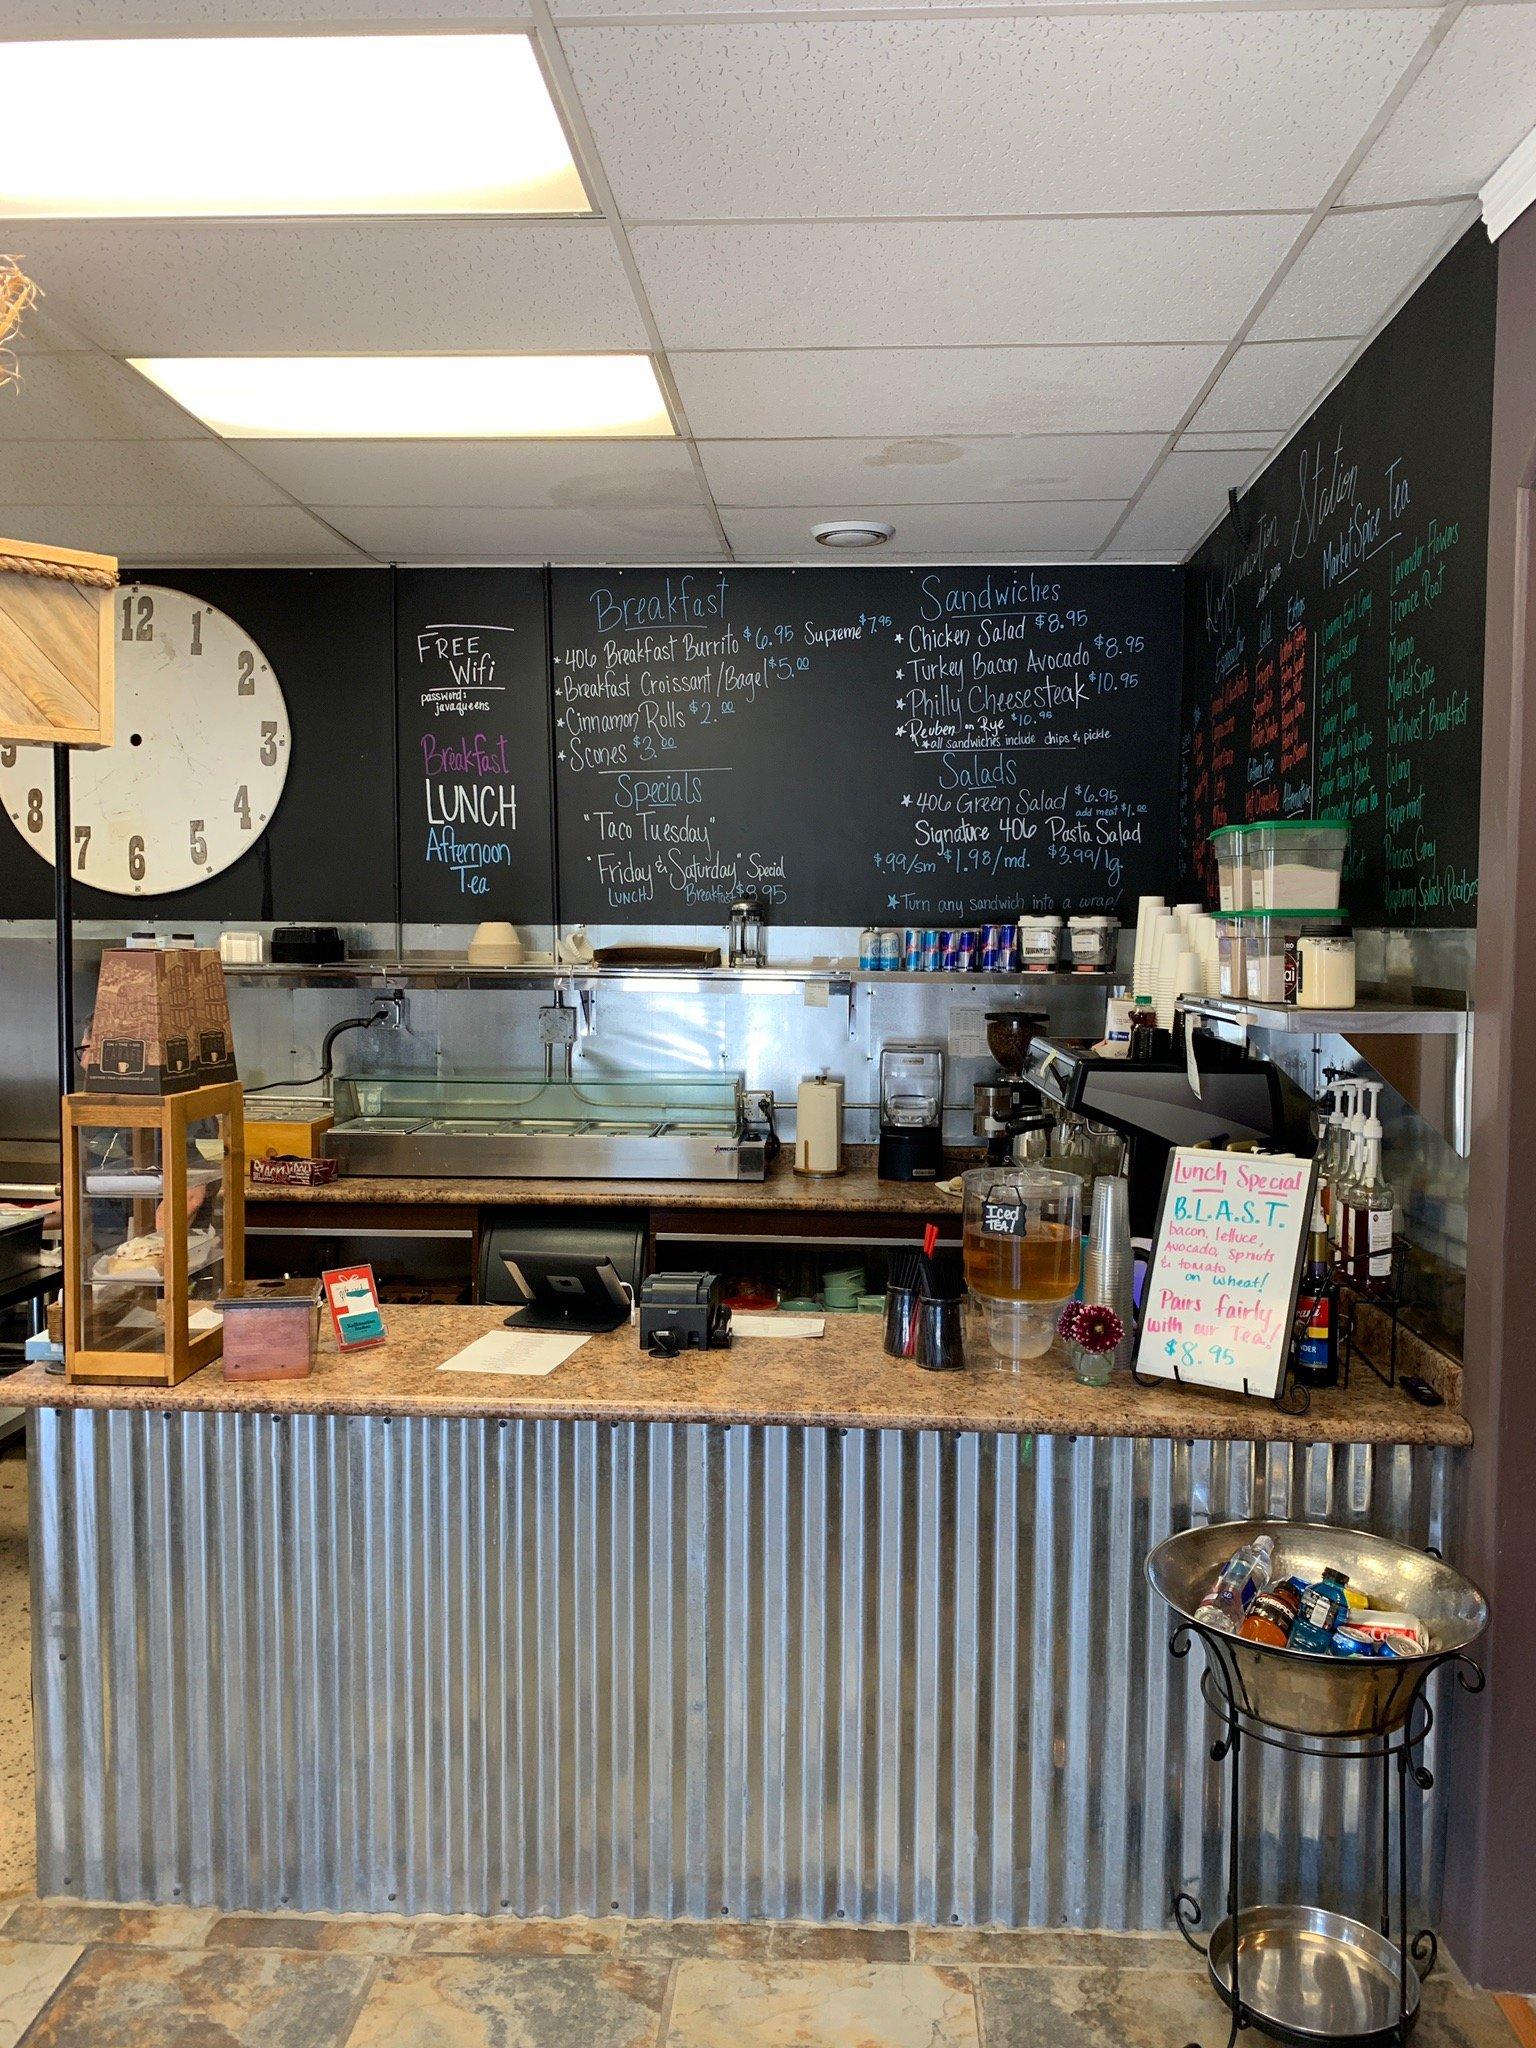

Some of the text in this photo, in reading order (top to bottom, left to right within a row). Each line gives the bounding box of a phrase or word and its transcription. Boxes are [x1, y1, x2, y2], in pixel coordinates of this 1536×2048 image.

[1289, 425, 1358, 563] Station
[1385, 458, 1410, 521] Tea
[1391, 519, 1459, 596] Lavender Flowers
[590, 575, 728, 632] Breakfast
[921, 572, 1060, 621] Sandwiches
[1421, 561, 1446, 609] Root
[121, 595, 154, 641] 12
[190, 610, 202, 656] 1
[910, 610, 1088, 653] Chicken Salad $8.95
[417, 632, 480, 663] FREE
[565, 614, 892, 670] 406 Breakfast Burrito $6.95 Supreme $7.95
[237, 650, 255, 696] 2
[449, 653, 496, 685] Wifi
[563, 671, 630, 702] Breakfast
[641, 667, 712, 697] Croissant
[768, 657, 810, 680] $5.00
[907, 634, 1145, 692] Turkey Bacon Avocado $8.95
[420, 689, 467, 706] password:
[434, 700, 490, 717] javaqueens
[907, 672, 1138, 732] Philly Cheesesteak $10.95
[566, 700, 735, 742] Cinnamon Rolls $2.00
[905, 718, 956, 747] Reuben
[978, 716, 1005, 737] Rye
[930, 737, 943, 749] all
[946, 732, 1001, 749] sandwiches
[1005, 731, 1036, 744] include
[1045, 730, 1070, 746] chips
[1084, 729, 1111, 745] pickle
[1388, 690, 1469, 747] Northwest Breakfast
[259, 720, 277, 766] 3
[420, 733, 510, 776] Breakfast
[570, 735, 677, 772] Scones $3.00
[615, 772, 702, 810] Specials
[940, 752, 1017, 789] Salads
[27, 788, 43, 833] 8
[233, 785, 251, 829] 4
[425, 778, 517, 830] LUNCH
[916, 784, 1118, 815] 406 Green Salad $6.95
[1075, 808, 1092, 817] add
[1096, 806, 1118, 816] meat
[1385, 784, 1426, 834] Peppermint
[74, 825, 91, 870] 7
[189, 819, 207, 865] 5
[425, 825, 511, 866] Afternoon
[915, 816, 1141, 856] Signature 406 Pasta Salad
[128, 835, 146, 881] 6
[747, 852, 786, 881] Special
[450, 864, 490, 894] Tea
[609, 881, 787, 908] LUNCH Breakfast $895
[896, 892, 930, 912] Turn
[938, 899, 964, 919] any
[969, 894, 1025, 912] sandwich
[1032, 894, 1055, 912] into
[1062, 900, 1071, 909] a
[1174, 1157, 1302, 1192] Lunch Special
[985, 1219, 1016, 1234] TEA!
[986, 1205, 1020, 1221] Iced
[1174, 1196, 1289, 1228] B.L.A.S.T.
[1216, 1226, 1265, 1247] lettuce,
[1160, 1258, 1227, 1274] & tomato
[1185, 1272, 1269, 1293] on wheat!
[1147, 1317, 1183, 1335] with
[1193, 1321, 1217, 1337] our
[1159, 1288, 1273, 1331] Pairs fairly
[1164, 1338, 1235, 1367] $8.95
